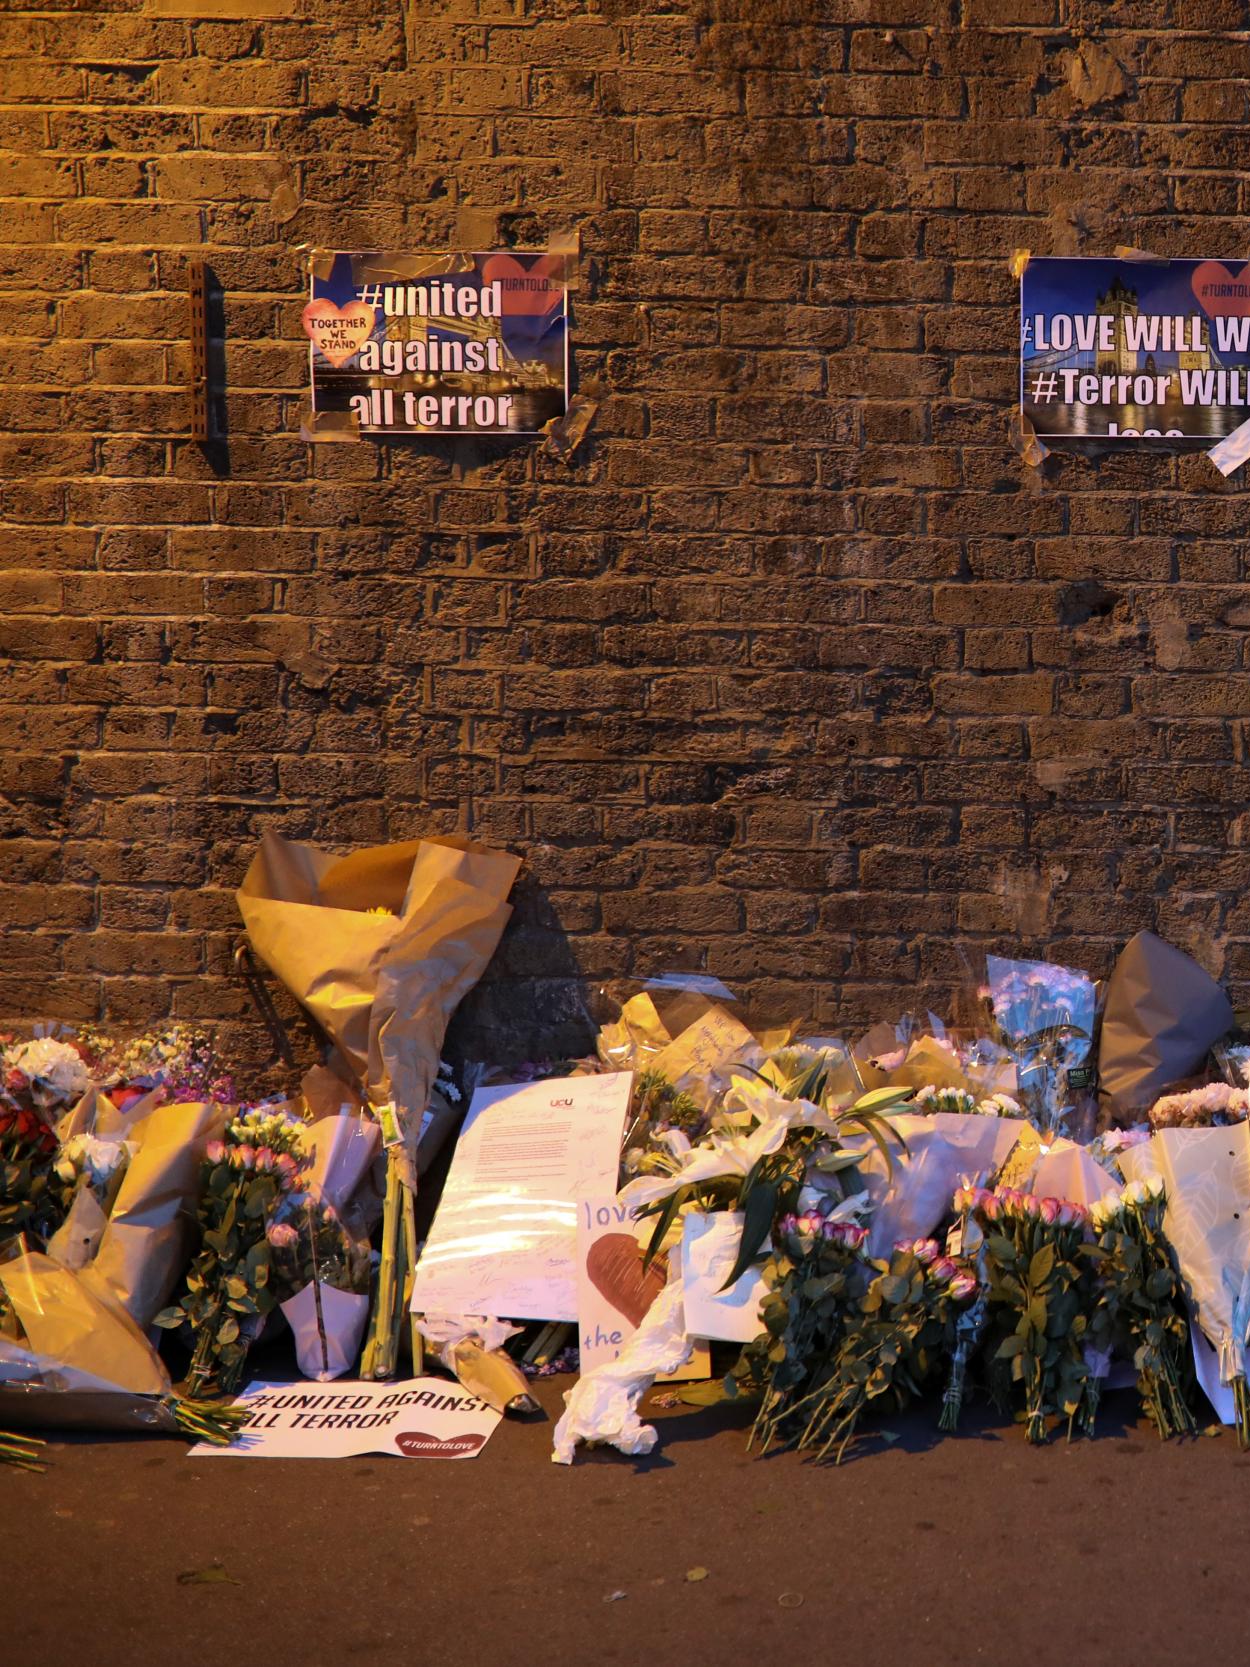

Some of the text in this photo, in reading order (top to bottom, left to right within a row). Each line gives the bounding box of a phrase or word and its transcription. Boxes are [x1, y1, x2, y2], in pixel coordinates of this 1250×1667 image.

[356, 280, 502, 317] #united
[309, 317, 367, 329] TOGETHER
[325, 329, 347, 339] WE
[1124, 315, 1206, 352] WILL
[320, 339, 356, 350] STAND
[359, 335, 500, 375] against
[1032, 368, 1171, 405] #Terror
[349, 389, 513, 426] all terror
[585, 1202, 641, 1230] love
[584, 1324, 623, 1350] the
[249, 1391, 491, 1412] #UNITED AGAINST
[290, 1410, 399, 1429] TERROR
[402, 1440, 476, 1450] #TURNTOLOVE
